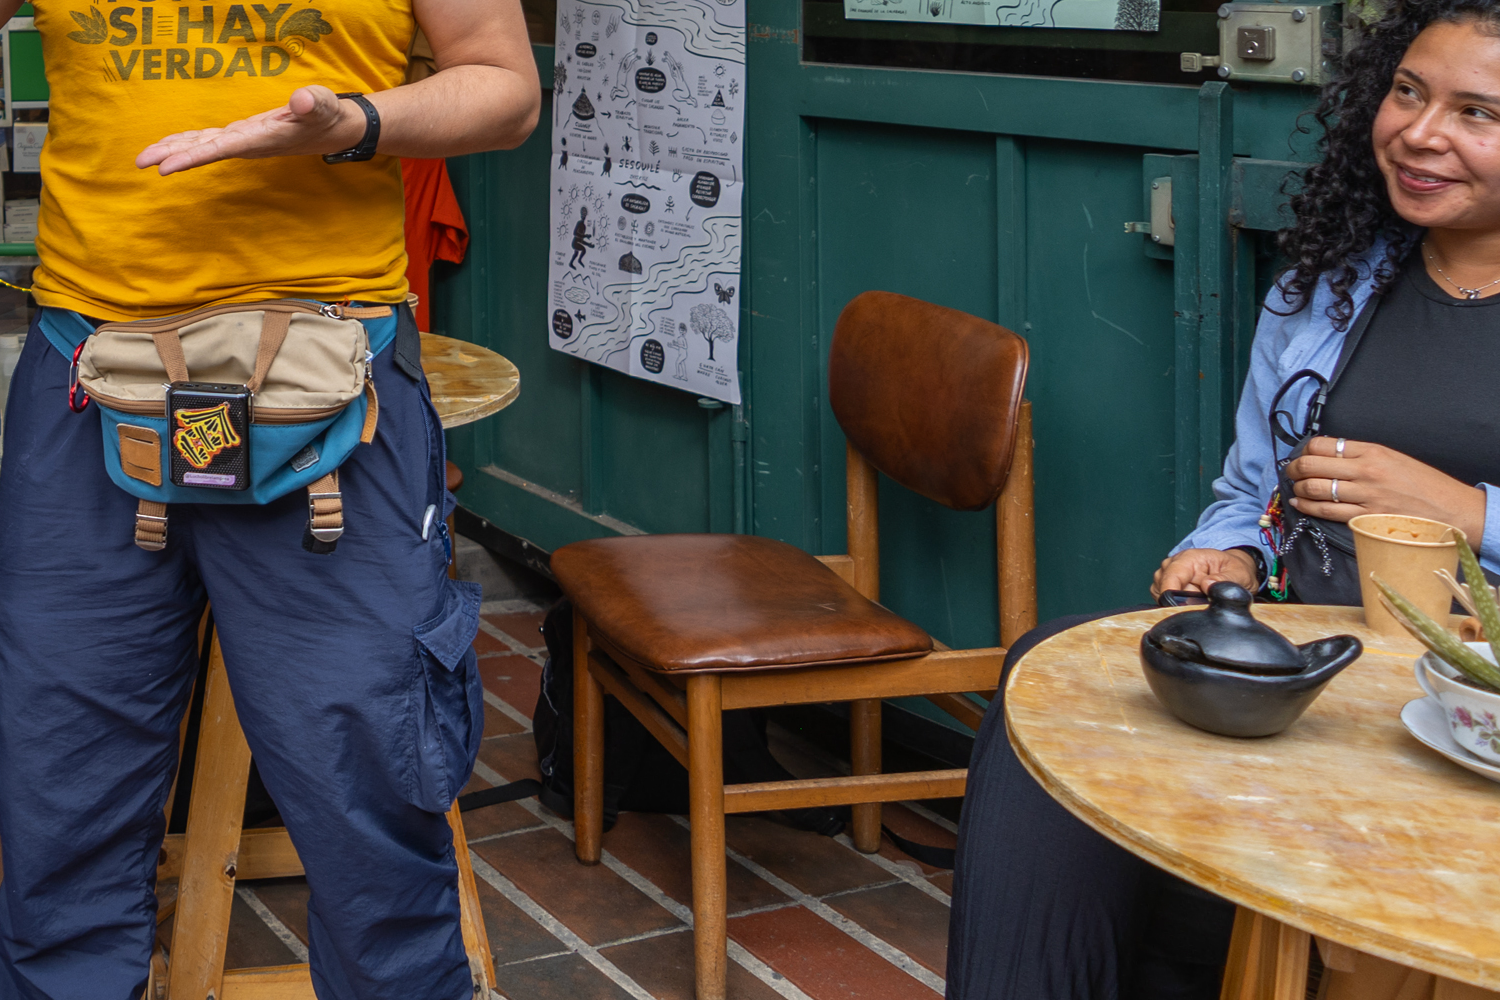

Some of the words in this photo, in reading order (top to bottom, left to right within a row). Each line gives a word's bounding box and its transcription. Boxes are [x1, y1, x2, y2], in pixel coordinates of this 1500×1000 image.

[108, 6, 153, 46] SI
[176, 3, 293, 44] HAY
[108, 45, 291, 81] VERDAD
